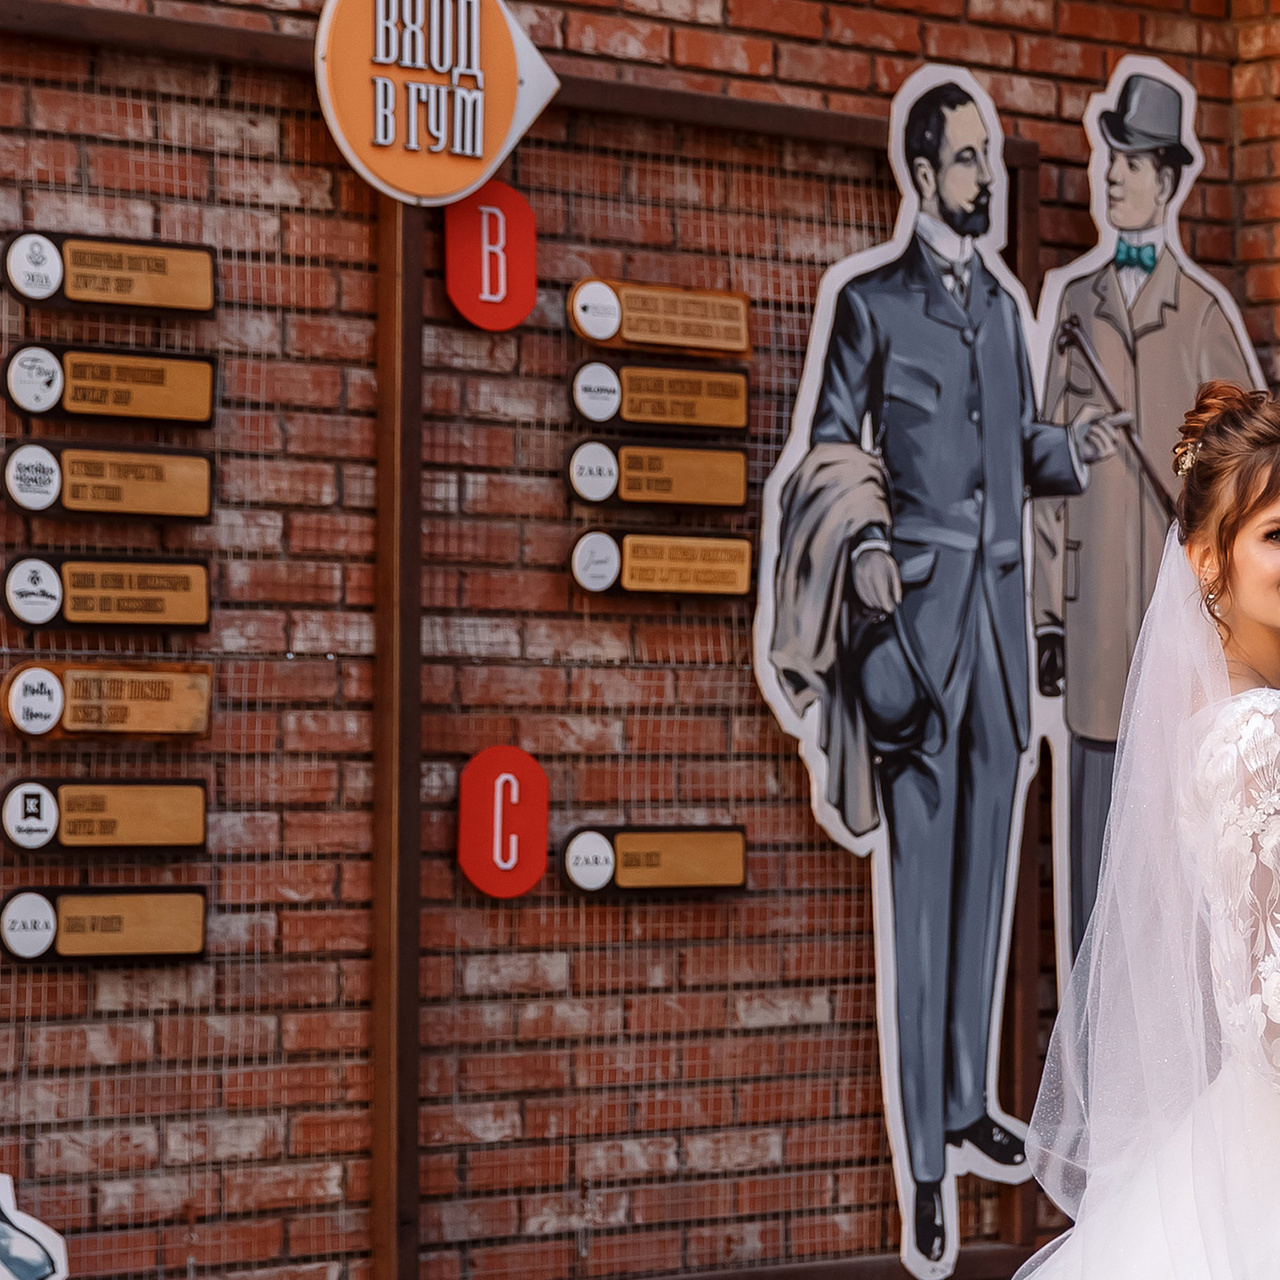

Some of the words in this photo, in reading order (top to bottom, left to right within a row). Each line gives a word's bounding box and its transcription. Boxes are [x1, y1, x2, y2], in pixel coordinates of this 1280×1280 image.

[371, 76, 396, 147] В
[405, 81, 485, 159] ГУМ
[571, 854, 613, 867] ZARA
[8, 919, 51, 931] ZARA
